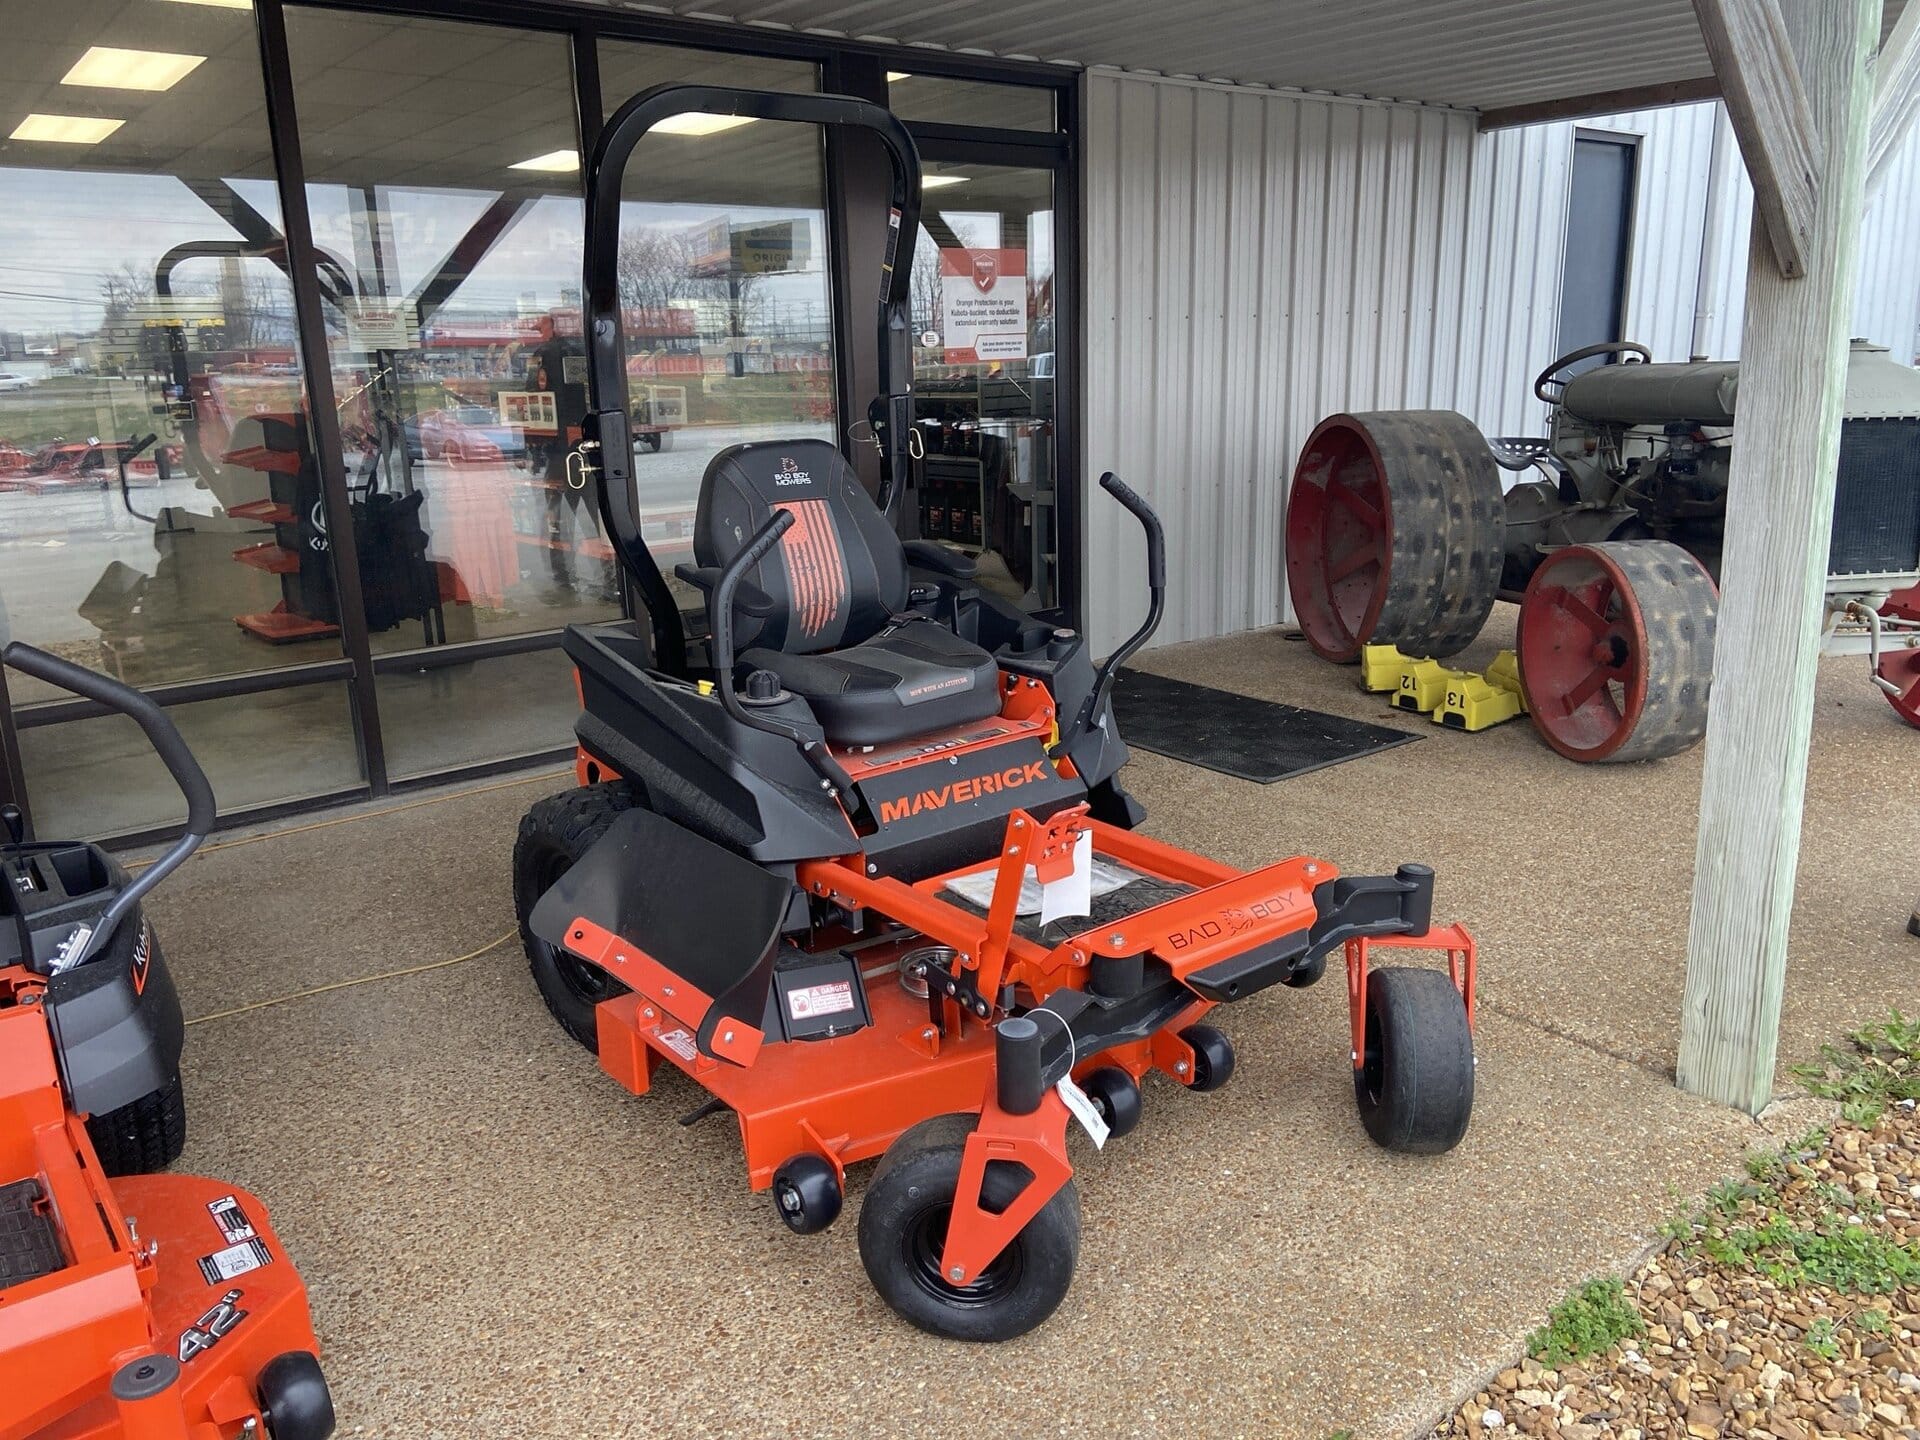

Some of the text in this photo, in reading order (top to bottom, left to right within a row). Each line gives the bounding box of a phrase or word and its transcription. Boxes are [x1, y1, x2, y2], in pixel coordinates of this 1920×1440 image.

[956, 299, 973, 307] Orange
[1004, 299, 1015, 307] your
[996, 308, 1020, 316] deductible
[978, 319, 999, 327] warranty
[774, 472, 791, 480] BAD
[776, 478, 812, 486] MOWERS
[1447, 691, 1465, 709] 13
[880, 760, 1048, 824] MAVERICK
[1168, 891, 1295, 950] BAD BOY
[820, 984, 849, 995] DANGER
